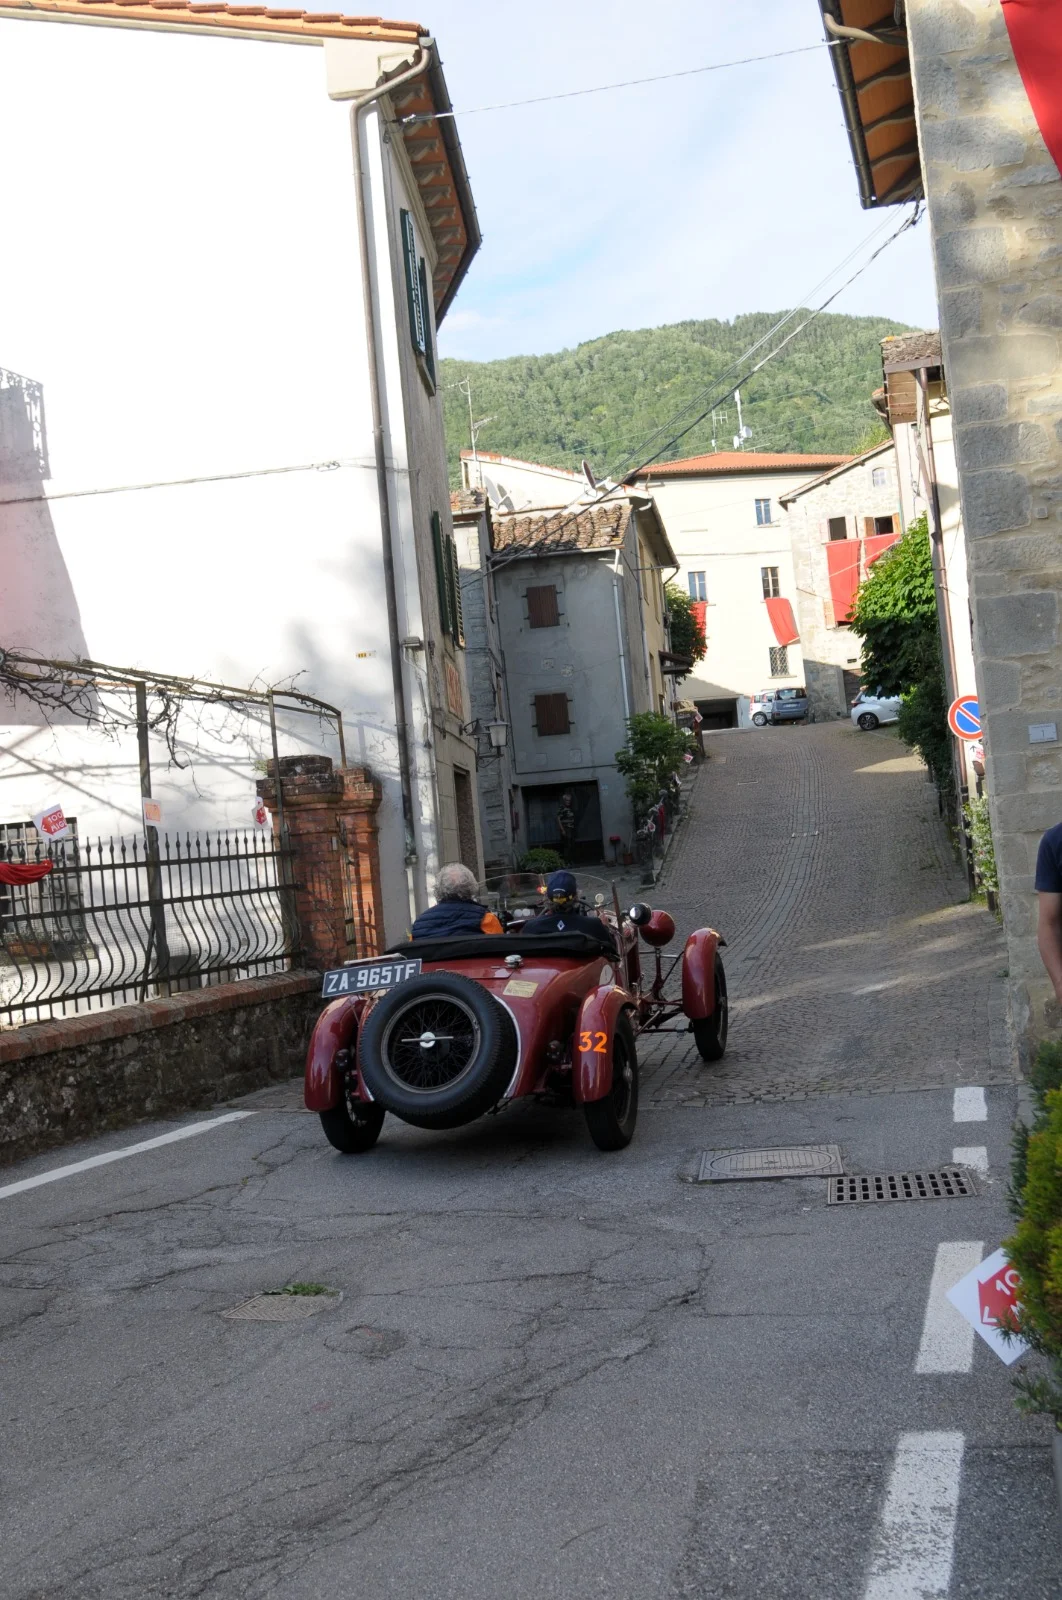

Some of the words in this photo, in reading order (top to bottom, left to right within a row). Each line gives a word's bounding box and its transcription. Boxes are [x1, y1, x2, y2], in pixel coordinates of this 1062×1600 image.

[327, 972, 349, 993] ZA
[356, 963, 416, 987] 965TF
[578, 1031, 608, 1054] 32
